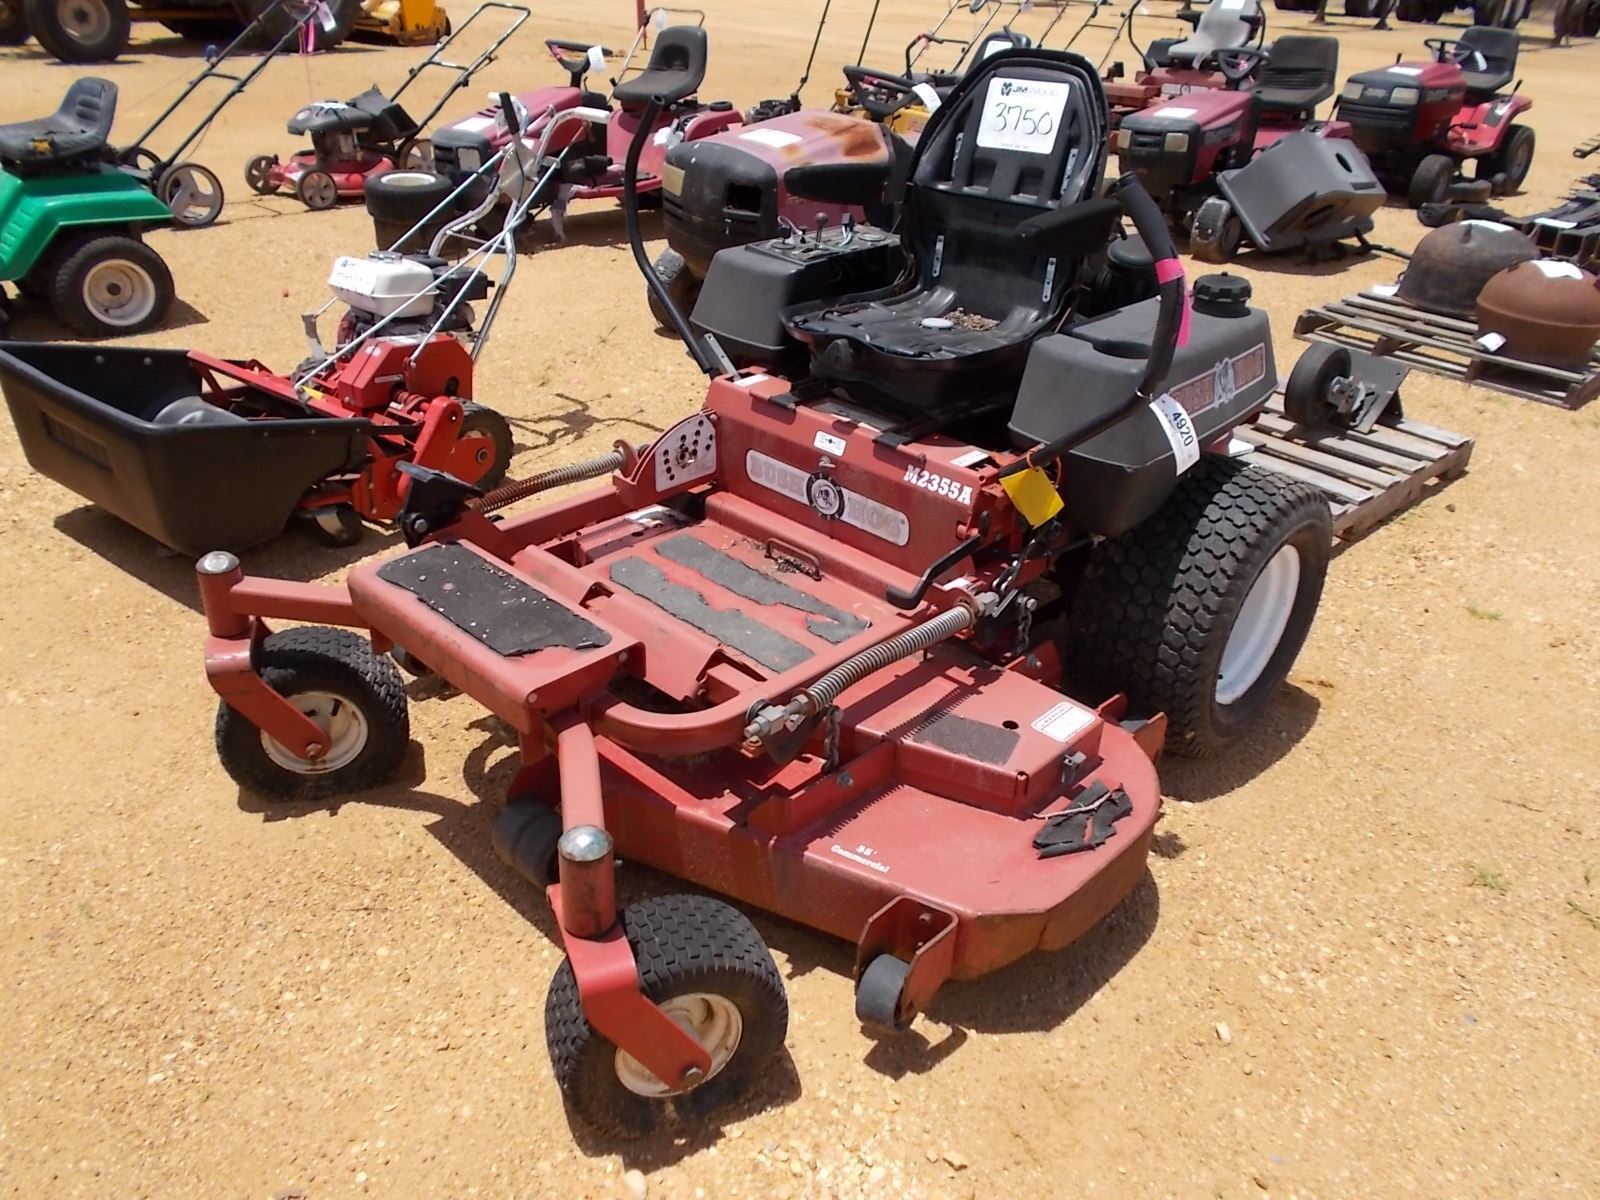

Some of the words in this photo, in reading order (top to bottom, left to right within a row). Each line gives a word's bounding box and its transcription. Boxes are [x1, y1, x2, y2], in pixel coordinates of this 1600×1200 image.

[993, 102, 1053, 135] 3750
[1172, 411, 1194, 447] 4920
[749, 455, 805, 498] BUSH
[903, 464, 974, 505] M2355A
